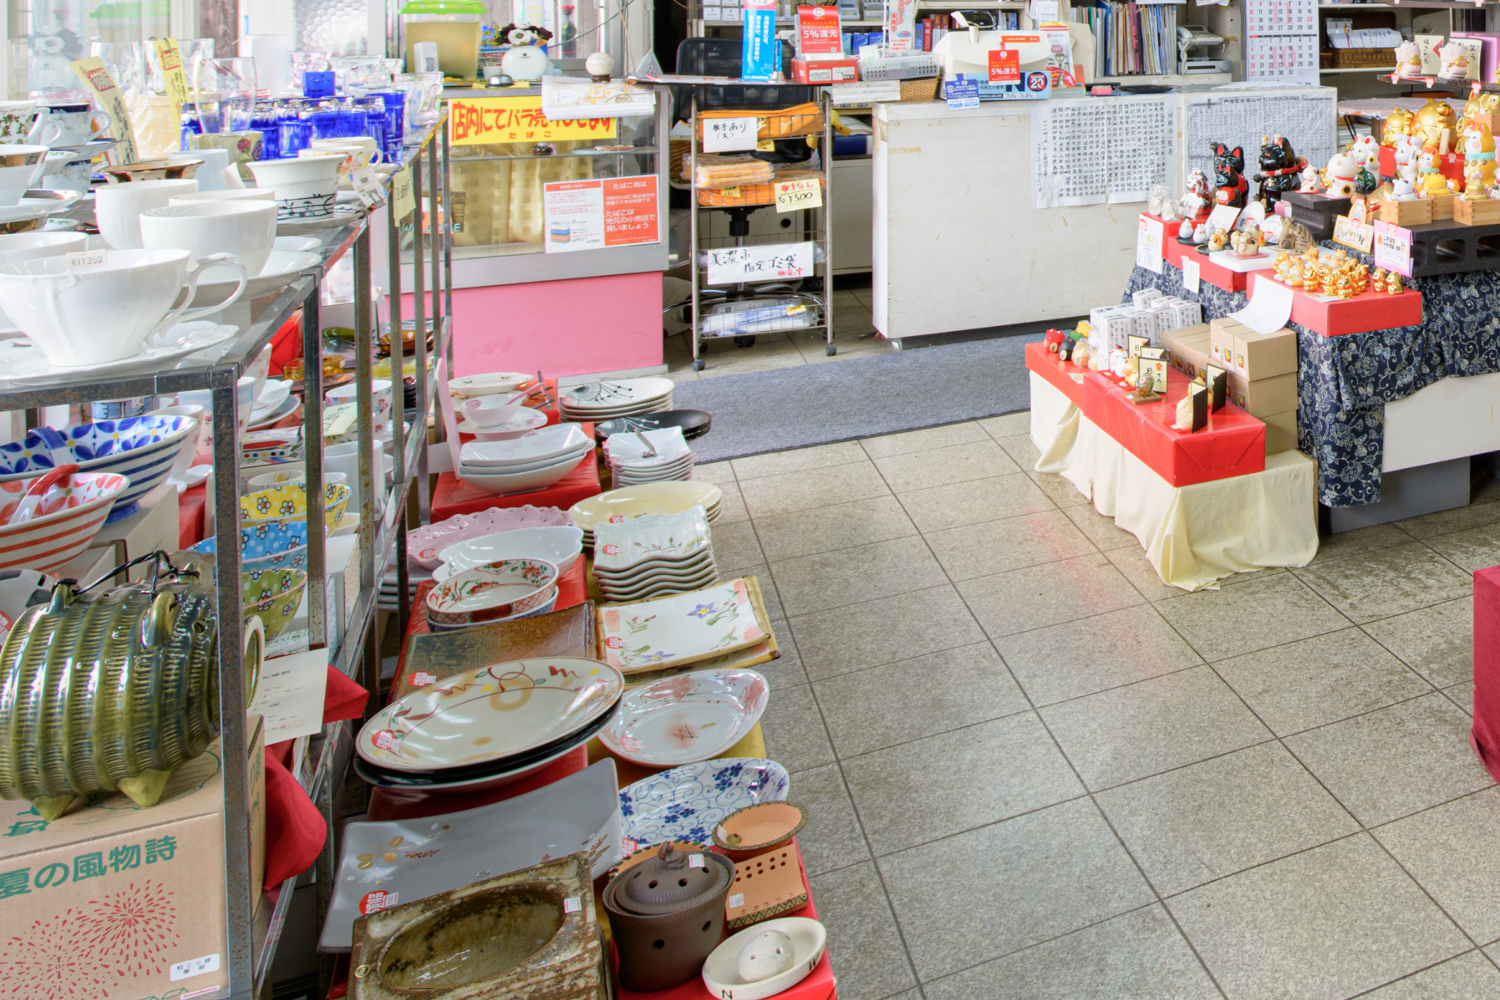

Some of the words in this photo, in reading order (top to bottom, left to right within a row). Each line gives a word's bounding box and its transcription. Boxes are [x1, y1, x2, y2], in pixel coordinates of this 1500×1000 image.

[803, 29, 838, 39] 5%還元
[508, 131, 551, 139] たばこ
[613, 181, 647, 189] たばこ税は
[605, 209, 634, 217] たばこは
[605, 214, 656, 224] 地元の小売店で
[606, 222, 649, 232] 買いましょう
[710, 249, 751, 267] 美濃市
[744, 254, 797, 274] 指定ゴミ袋
[0, 835, 177, 899] 夏の風物詩
[722, 989, 732, 999] N
